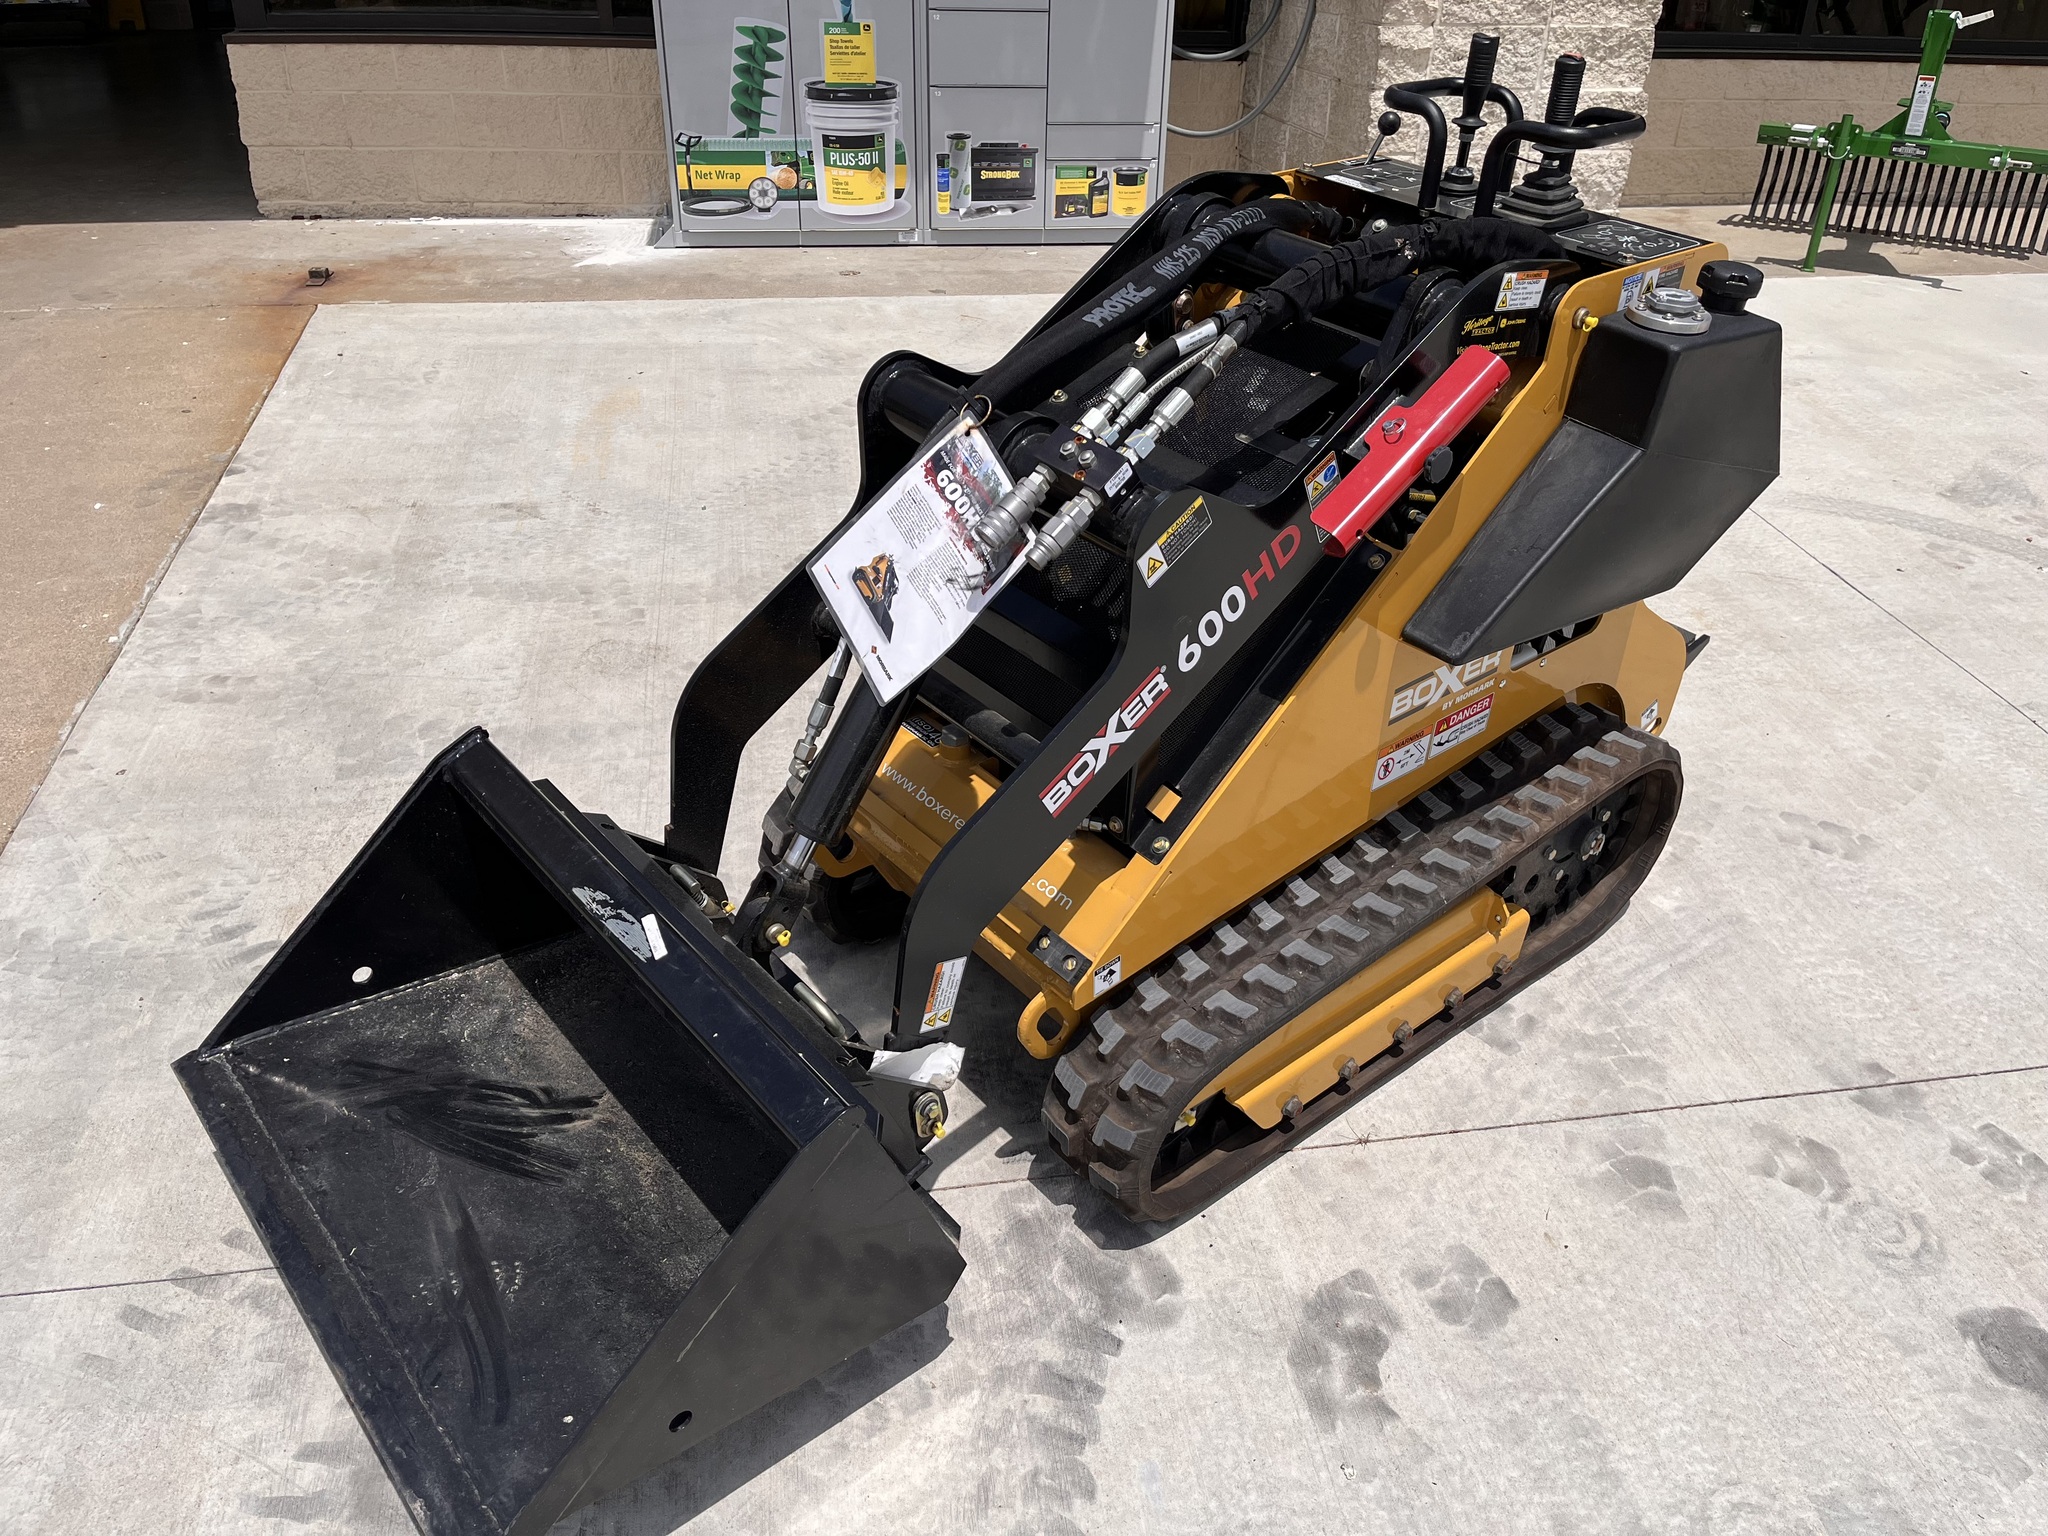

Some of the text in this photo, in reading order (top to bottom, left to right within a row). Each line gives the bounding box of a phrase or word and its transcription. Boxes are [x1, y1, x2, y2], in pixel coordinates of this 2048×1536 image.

[830, 152, 871, 166] PLUS-50
[694, 170, 741, 183] Net Wrap
[1152, 244, 1201, 280] NHS-225
[1162, 514, 1194, 548] BURN HAZARD!
[1171, 505, 1196, 532] CAUTION
[1162, 517, 1197, 553] DO NOT TOUCH!
[1442, 678, 1496, 710] BY MORBARK
[1450, 698, 1490, 726] DANGER
[1042, 672, 1170, 814] BOXER
[1394, 730, 1424, 750] WARNING
[931, 972, 940, 998] WARNING
